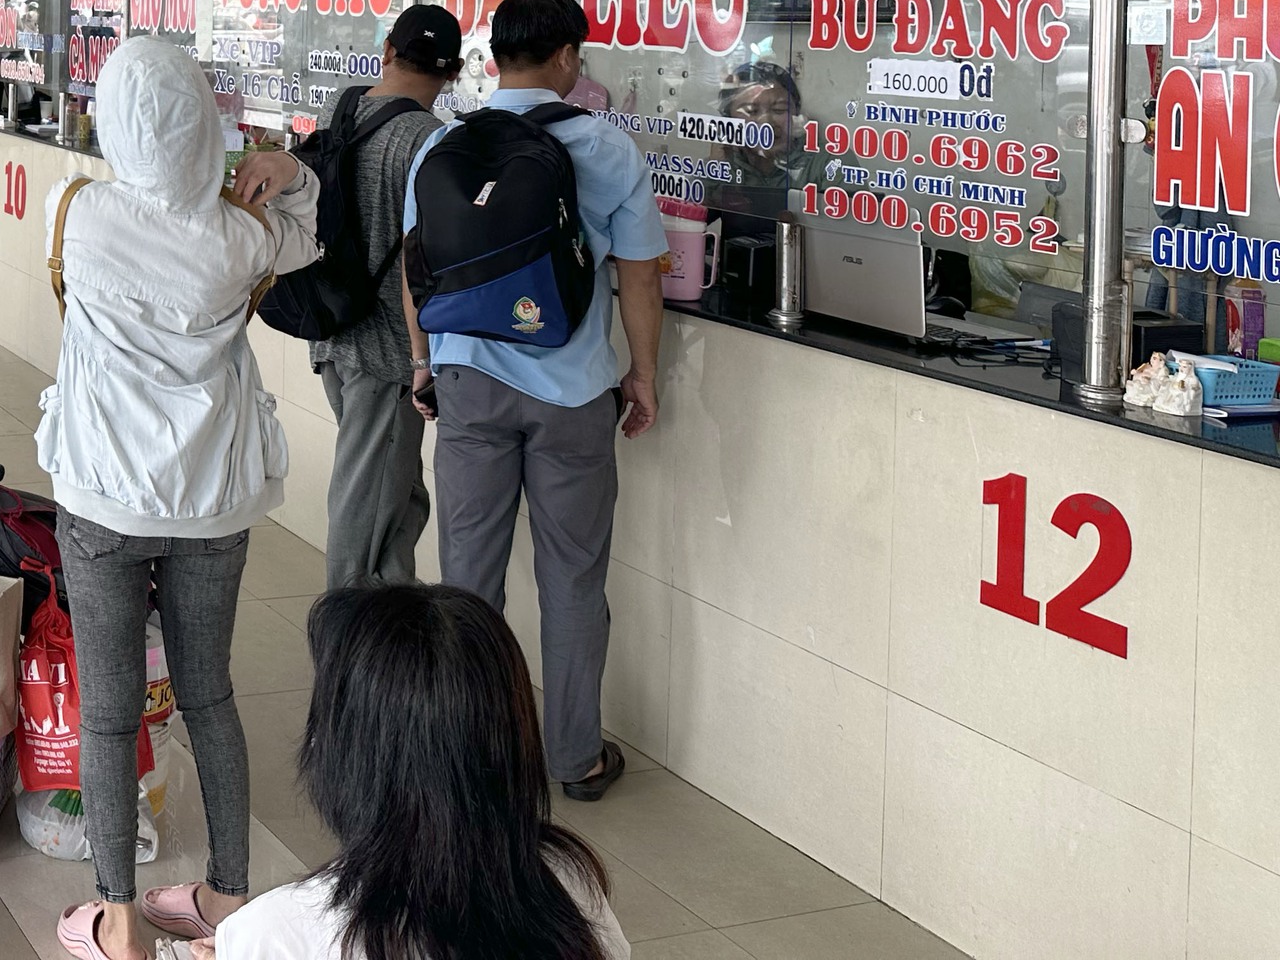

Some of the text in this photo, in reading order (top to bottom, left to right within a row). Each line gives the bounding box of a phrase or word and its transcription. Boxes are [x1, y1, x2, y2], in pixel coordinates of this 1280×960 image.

[69, 25, 87, 82] CÀ
[215, 37, 240, 61] Xe
[246, 39, 282, 66] VIP
[214, 69, 302, 105] Xe 16 Chỗ
[883, 62, 995, 101] 160.000 0đ
[645, 116, 674, 136] VIP
[680, 116, 743, 145] 420.000đ
[865, 101, 1006, 133] BÌNH PHƯỚC
[803, 120, 1061, 182] 1900.6962
[1154, 66, 1253, 216] AN
[645, 152, 732, 182] MASSAGE
[842, 165, 1026, 208] TP.HỒ CHÍ MINH
[4, 161, 27, 220] 10
[802, 183, 1060, 255] 1900.6952
[842, 255, 863, 266] ASUS
[1151, 223, 1280, 284] GIƯỜNG
[979, 472, 1133, 659] 12
